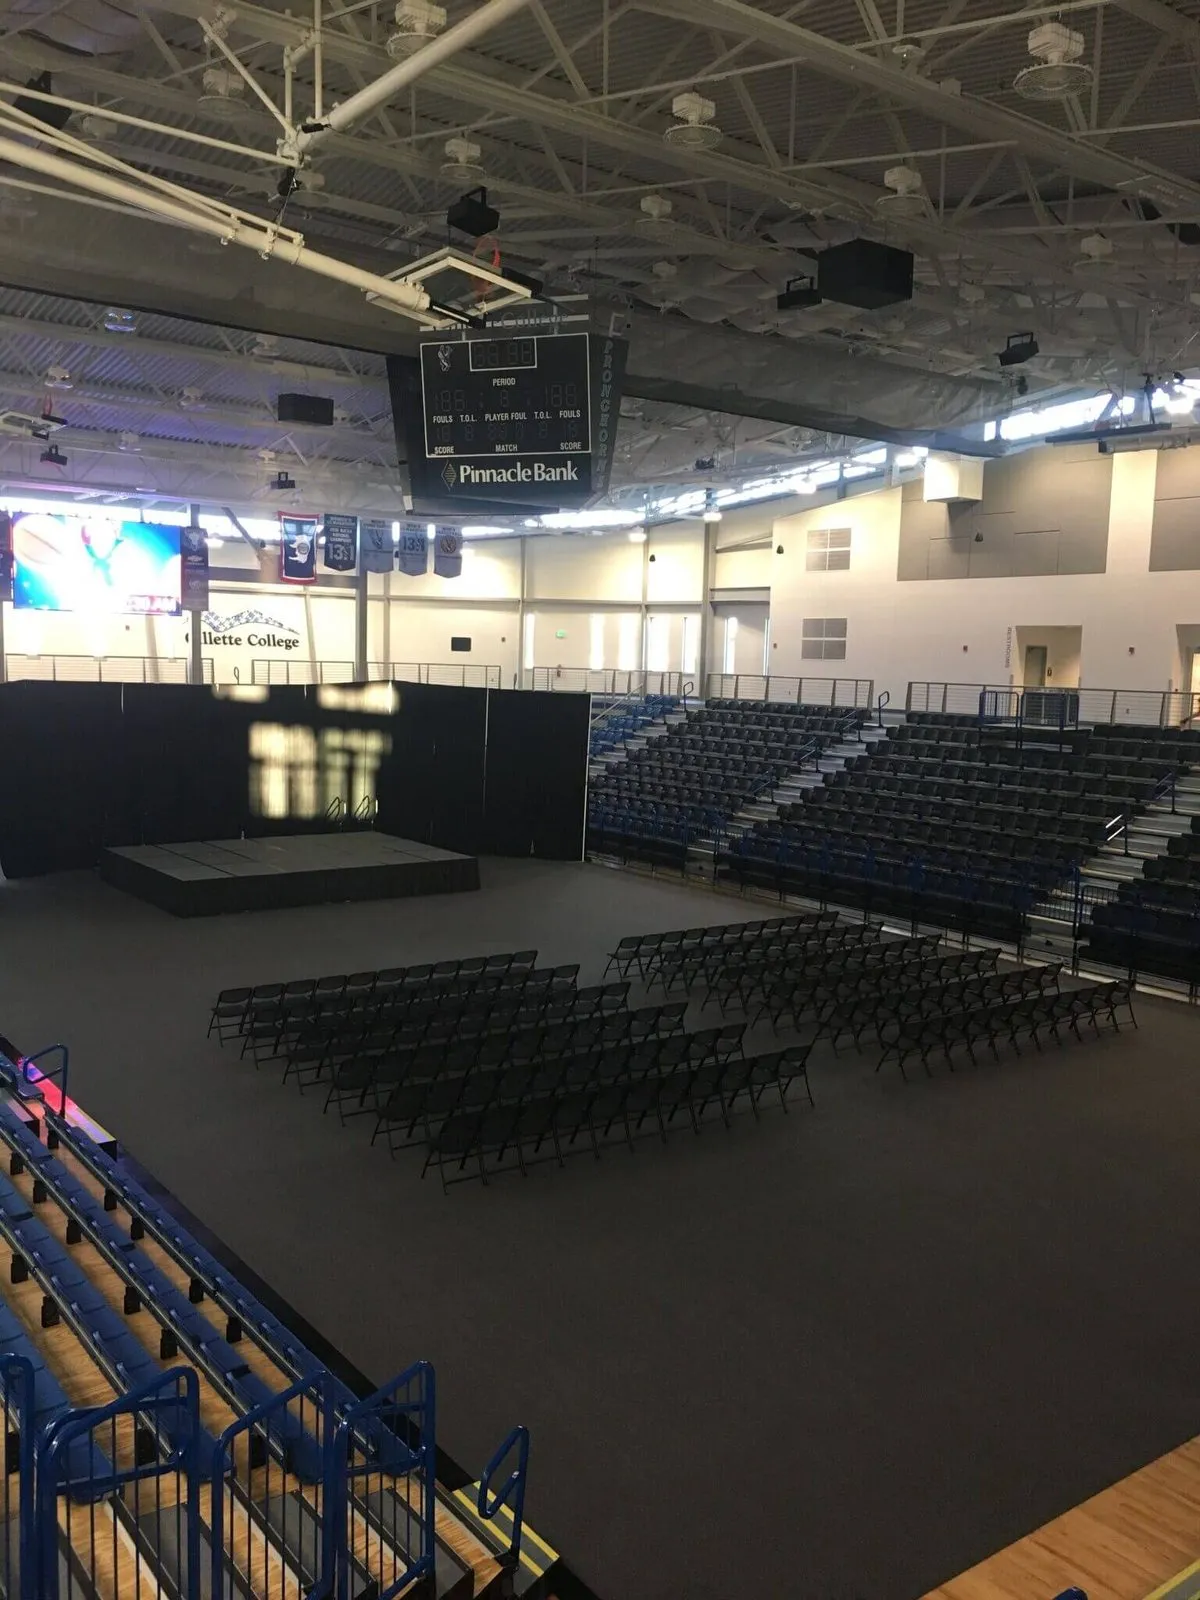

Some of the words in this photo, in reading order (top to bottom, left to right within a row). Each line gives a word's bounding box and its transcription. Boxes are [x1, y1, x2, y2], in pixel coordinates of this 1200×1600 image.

[492, 378, 516, 387] PERIOD
[460, 414, 478, 422] T.O.L.
[484, 412, 509, 421] PLAYER
[510, 412, 527, 420] FOUL
[534, 411, 552, 420] T.O.L.
[559, 410, 581, 418] FOULS
[432, 415, 453, 424] FOULS
[434, 446, 454, 454] SCORE
[495, 444, 518, 452] MATCH
[560, 442, 581, 450] SCORE
[459, 462, 532, 484] Pinnacle
[534, 460, 578, 481] Bank
[185, 631, 242, 646] llette
[247, 633, 300, 650] College
